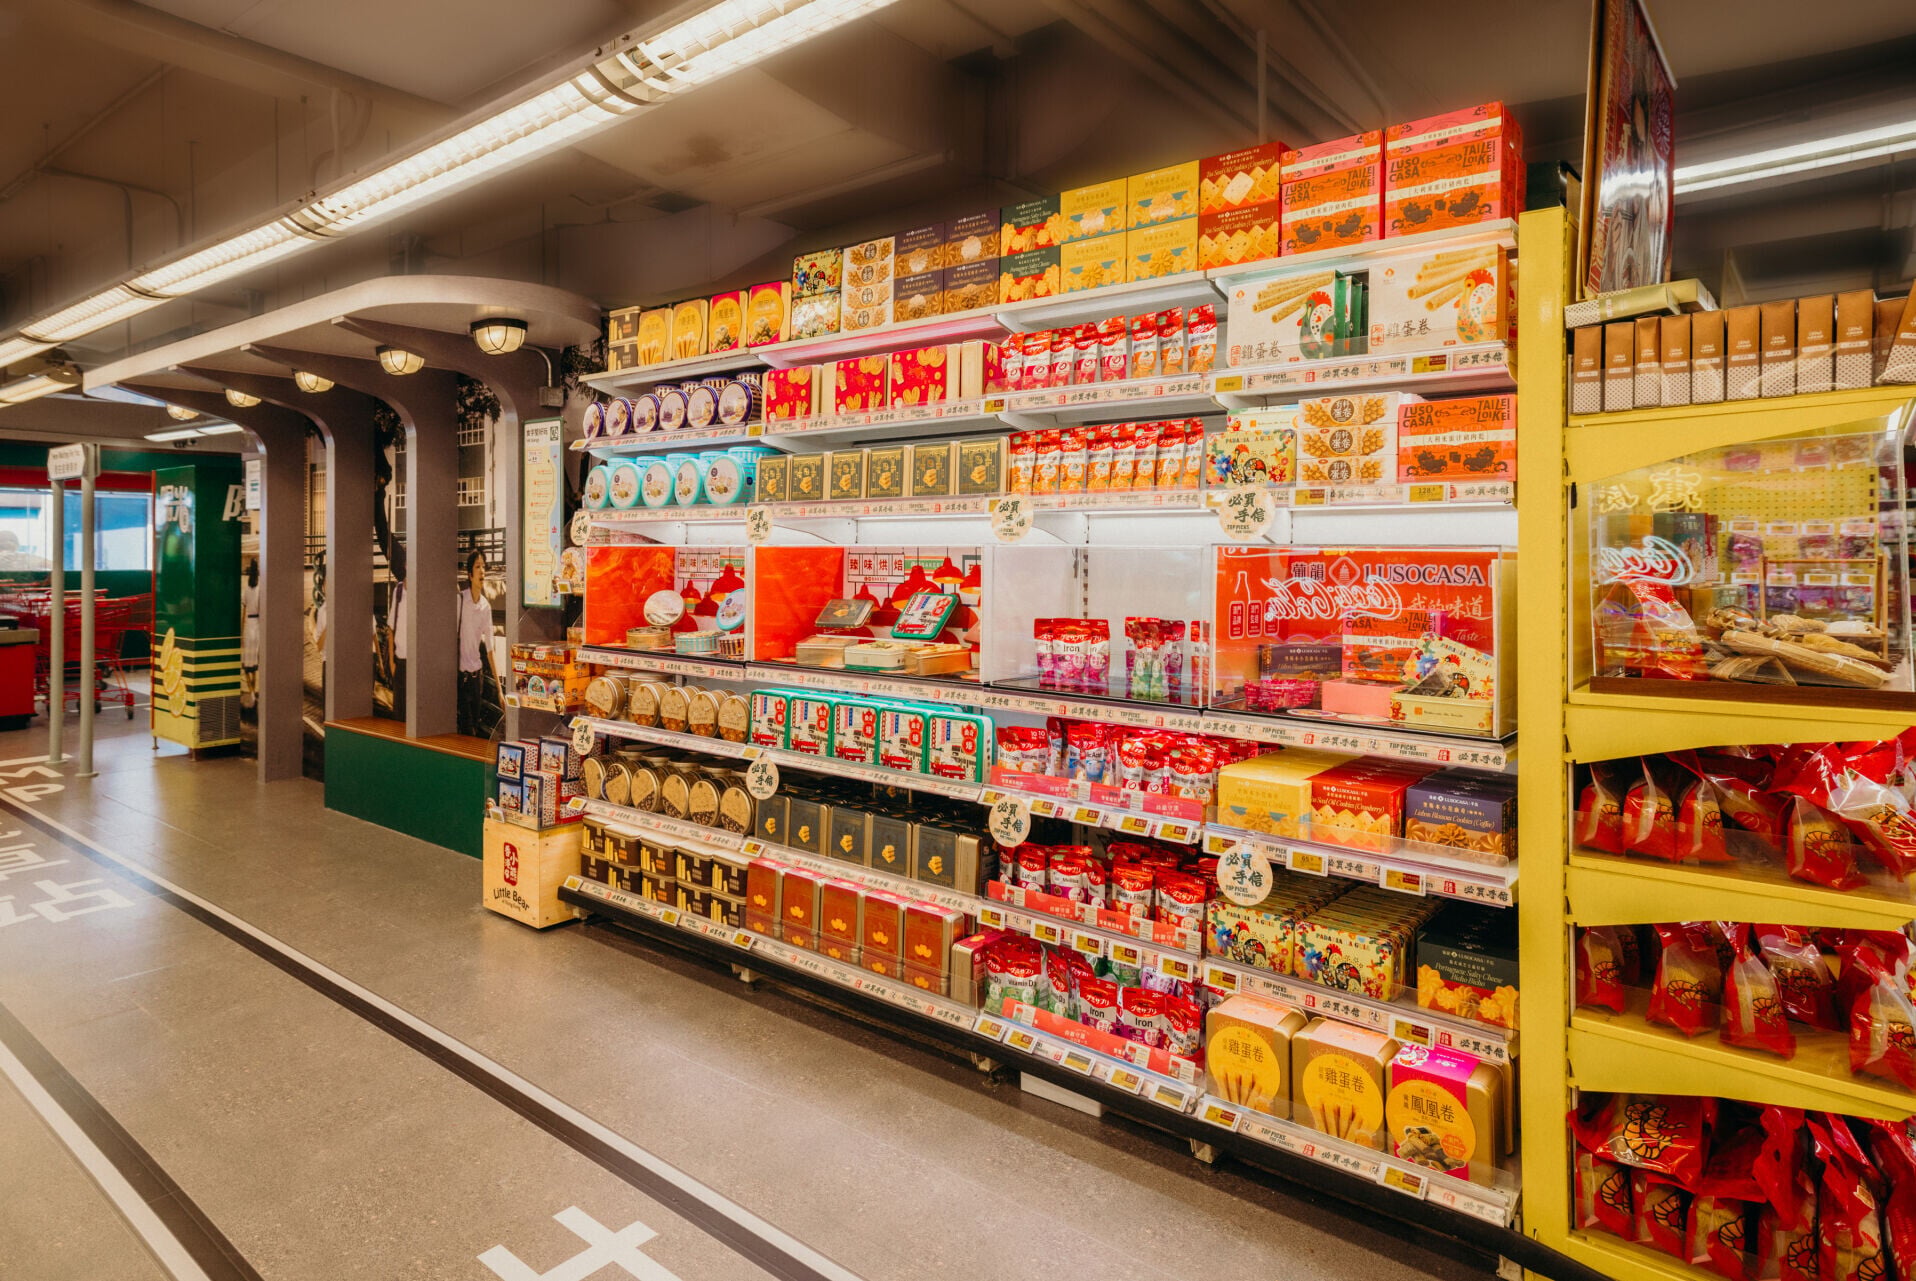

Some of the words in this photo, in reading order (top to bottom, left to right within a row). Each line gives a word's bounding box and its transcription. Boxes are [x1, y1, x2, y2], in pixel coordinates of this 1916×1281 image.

[1391, 157, 1419, 174] LUSO
[1389, 168, 1419, 182] CASA
[1286, 182, 1310, 197] LUSO
[1284, 192, 1310, 206] CASA
[1386, 318, 1431, 338] 雞蛋卷
[1404, 406, 1433, 419] LUSO
[1402, 416, 1434, 428] CASA
[1228, 492, 1256, 508] 必買
[1234, 508, 1265, 523] 手信
[1365, 565, 1485, 585] LUSOCASA
[1346, 620, 1371, 628] CASA
[998, 802, 1017, 813] 必買
[1001, 819, 1023, 833] 手信
[1226, 852, 1252, 870] 必買
[1232, 870, 1263, 887] 手信
[494, 888, 511, 899] Little
[513, 891, 529, 910] Bear
[1464, 886, 1508, 901] 必買手信
[1089, 1007, 1104, 1018] Iron
[1135, 1018, 1153, 1027] Iron
[1228, 1037, 1263, 1064] 雞蛋卷
[1324, 1066, 1364, 1094] 雞蛋卷
[1412, 1095, 1454, 1123] 鳳凰卷
